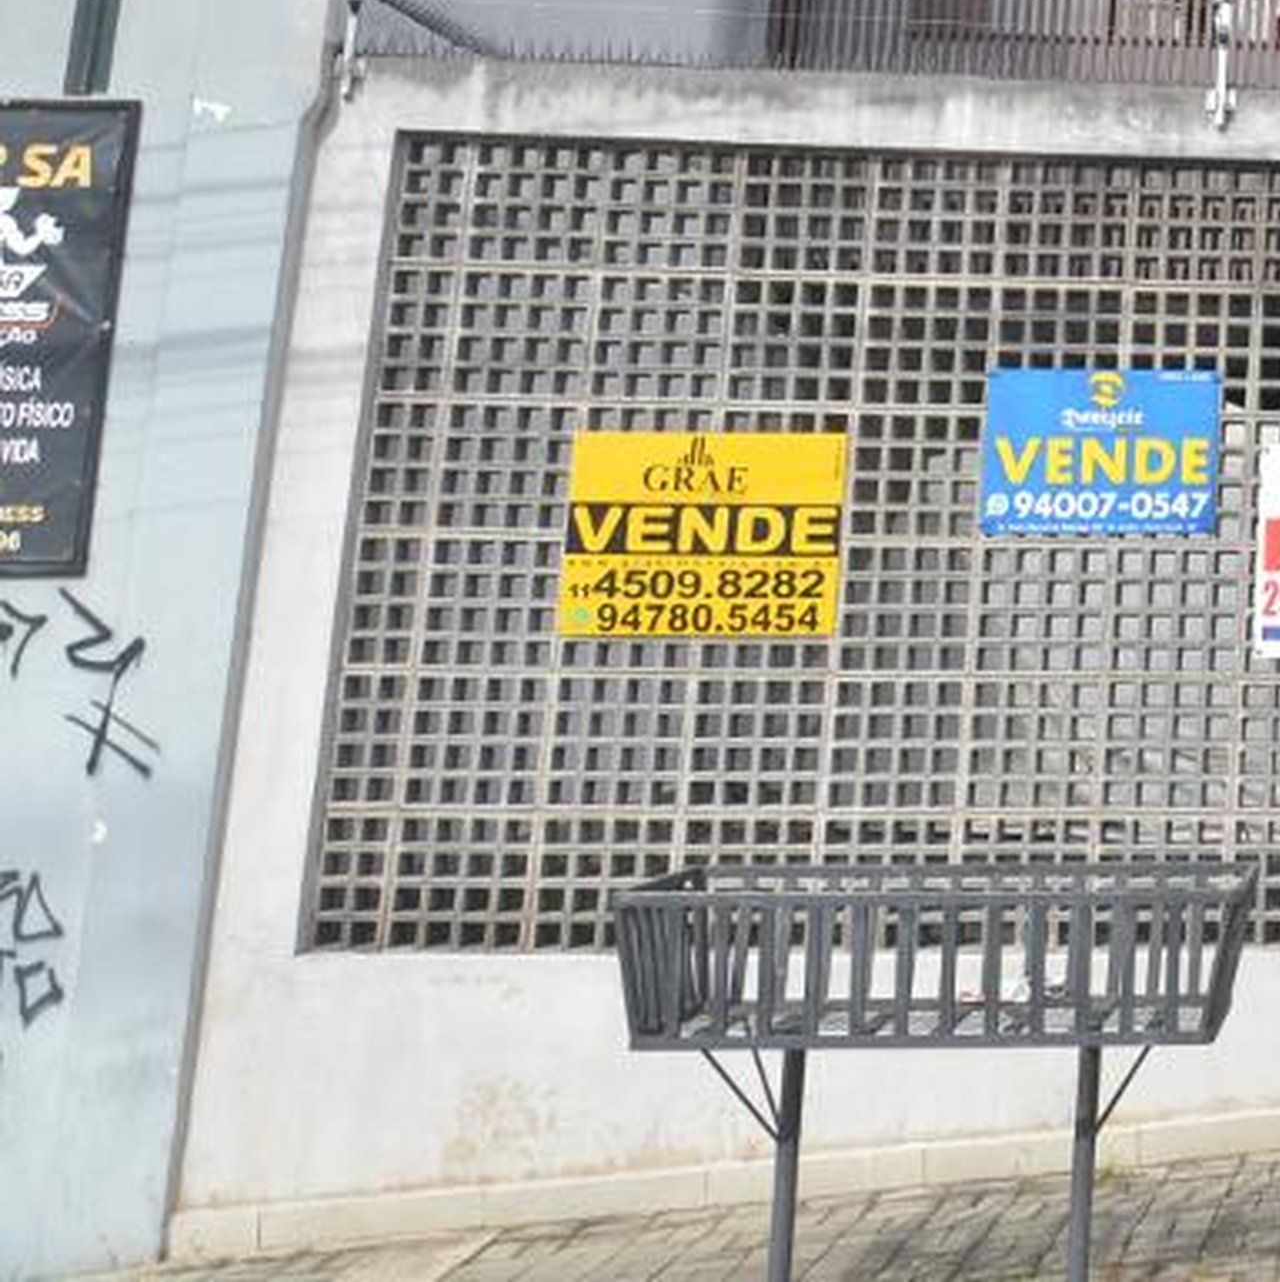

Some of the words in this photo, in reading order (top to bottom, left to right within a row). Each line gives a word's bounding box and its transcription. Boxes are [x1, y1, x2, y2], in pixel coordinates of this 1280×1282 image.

[994, 435, 1211, 486] VENDE
[643, 465, 748, 493] GRAE
[1012, 491, 1211, 519] 94007-0547
[572, 504, 839, 554] VENDE
[596, 602, 820, 632] 94780.5454
